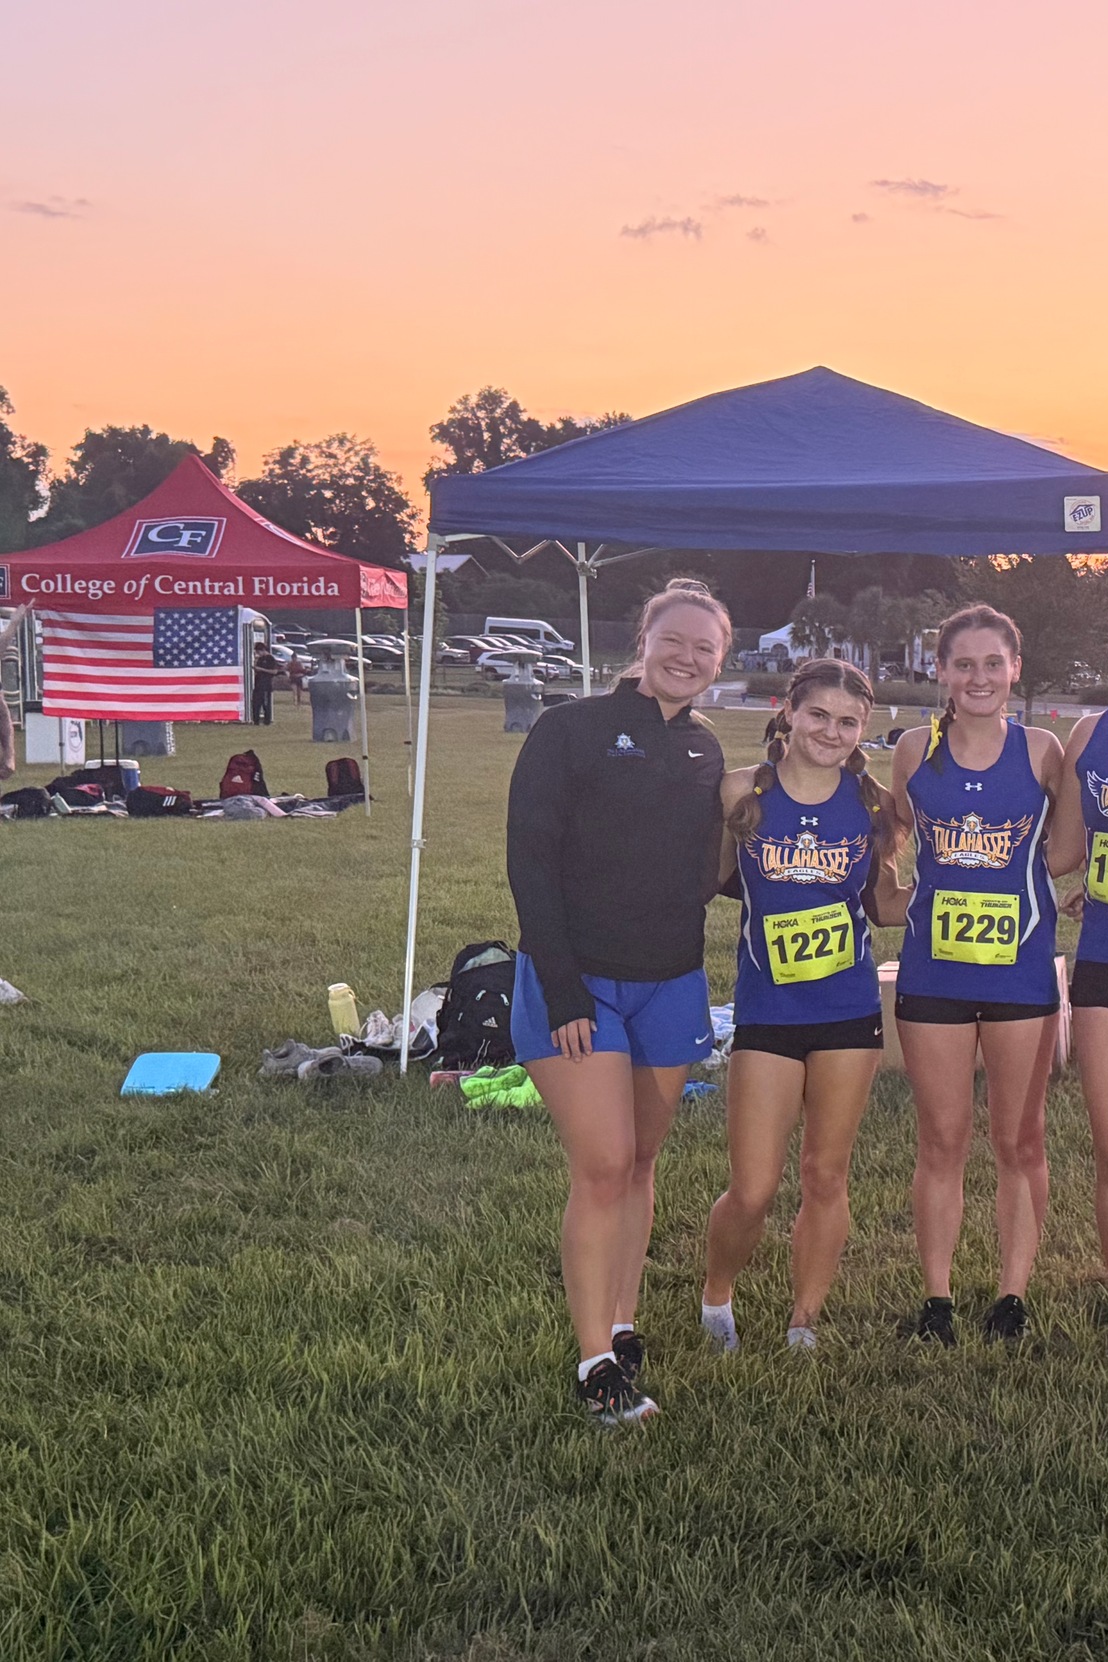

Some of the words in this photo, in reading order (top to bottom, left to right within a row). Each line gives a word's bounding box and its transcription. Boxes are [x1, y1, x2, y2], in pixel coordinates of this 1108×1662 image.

[147, 523, 206, 548] CF
[21, 574, 115, 599] College
[123, 574, 151, 600] of
[154, 575, 243, 596] Central
[252, 577, 340, 597] Florida
[932, 826, 1011, 860] TALLAHASSEE
[954, 852, 985, 860] EAGLES
[762, 843, 849, 876] TALLAHASSEE
[941, 897, 967, 907] HOKA
[773, 918, 798, 929] HOKA
[937, 912, 1016, 945] 1229
[772, 923, 849, 964] 1227
